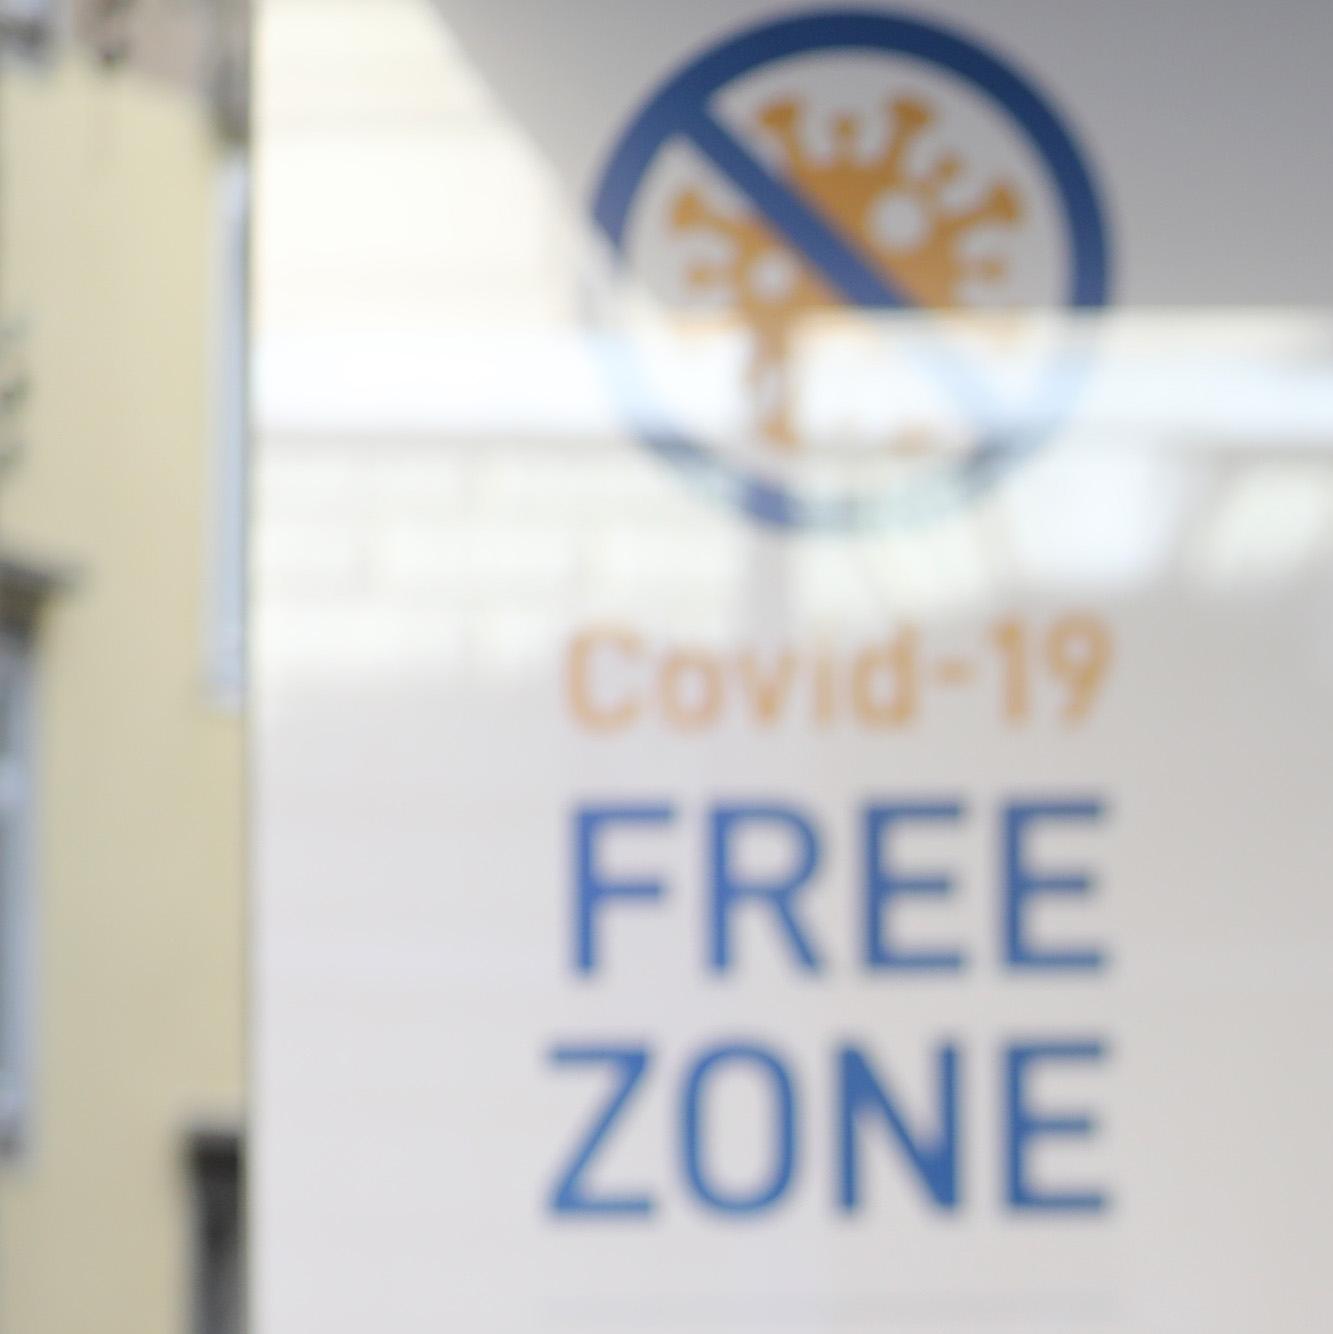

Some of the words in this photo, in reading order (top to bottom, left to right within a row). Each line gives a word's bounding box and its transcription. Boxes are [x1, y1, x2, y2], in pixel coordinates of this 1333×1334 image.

[564, 609, 1117, 731] Covid-19
[570, 796, 1111, 975] FREE
[546, 1038, 1111, 1217] ZONE
